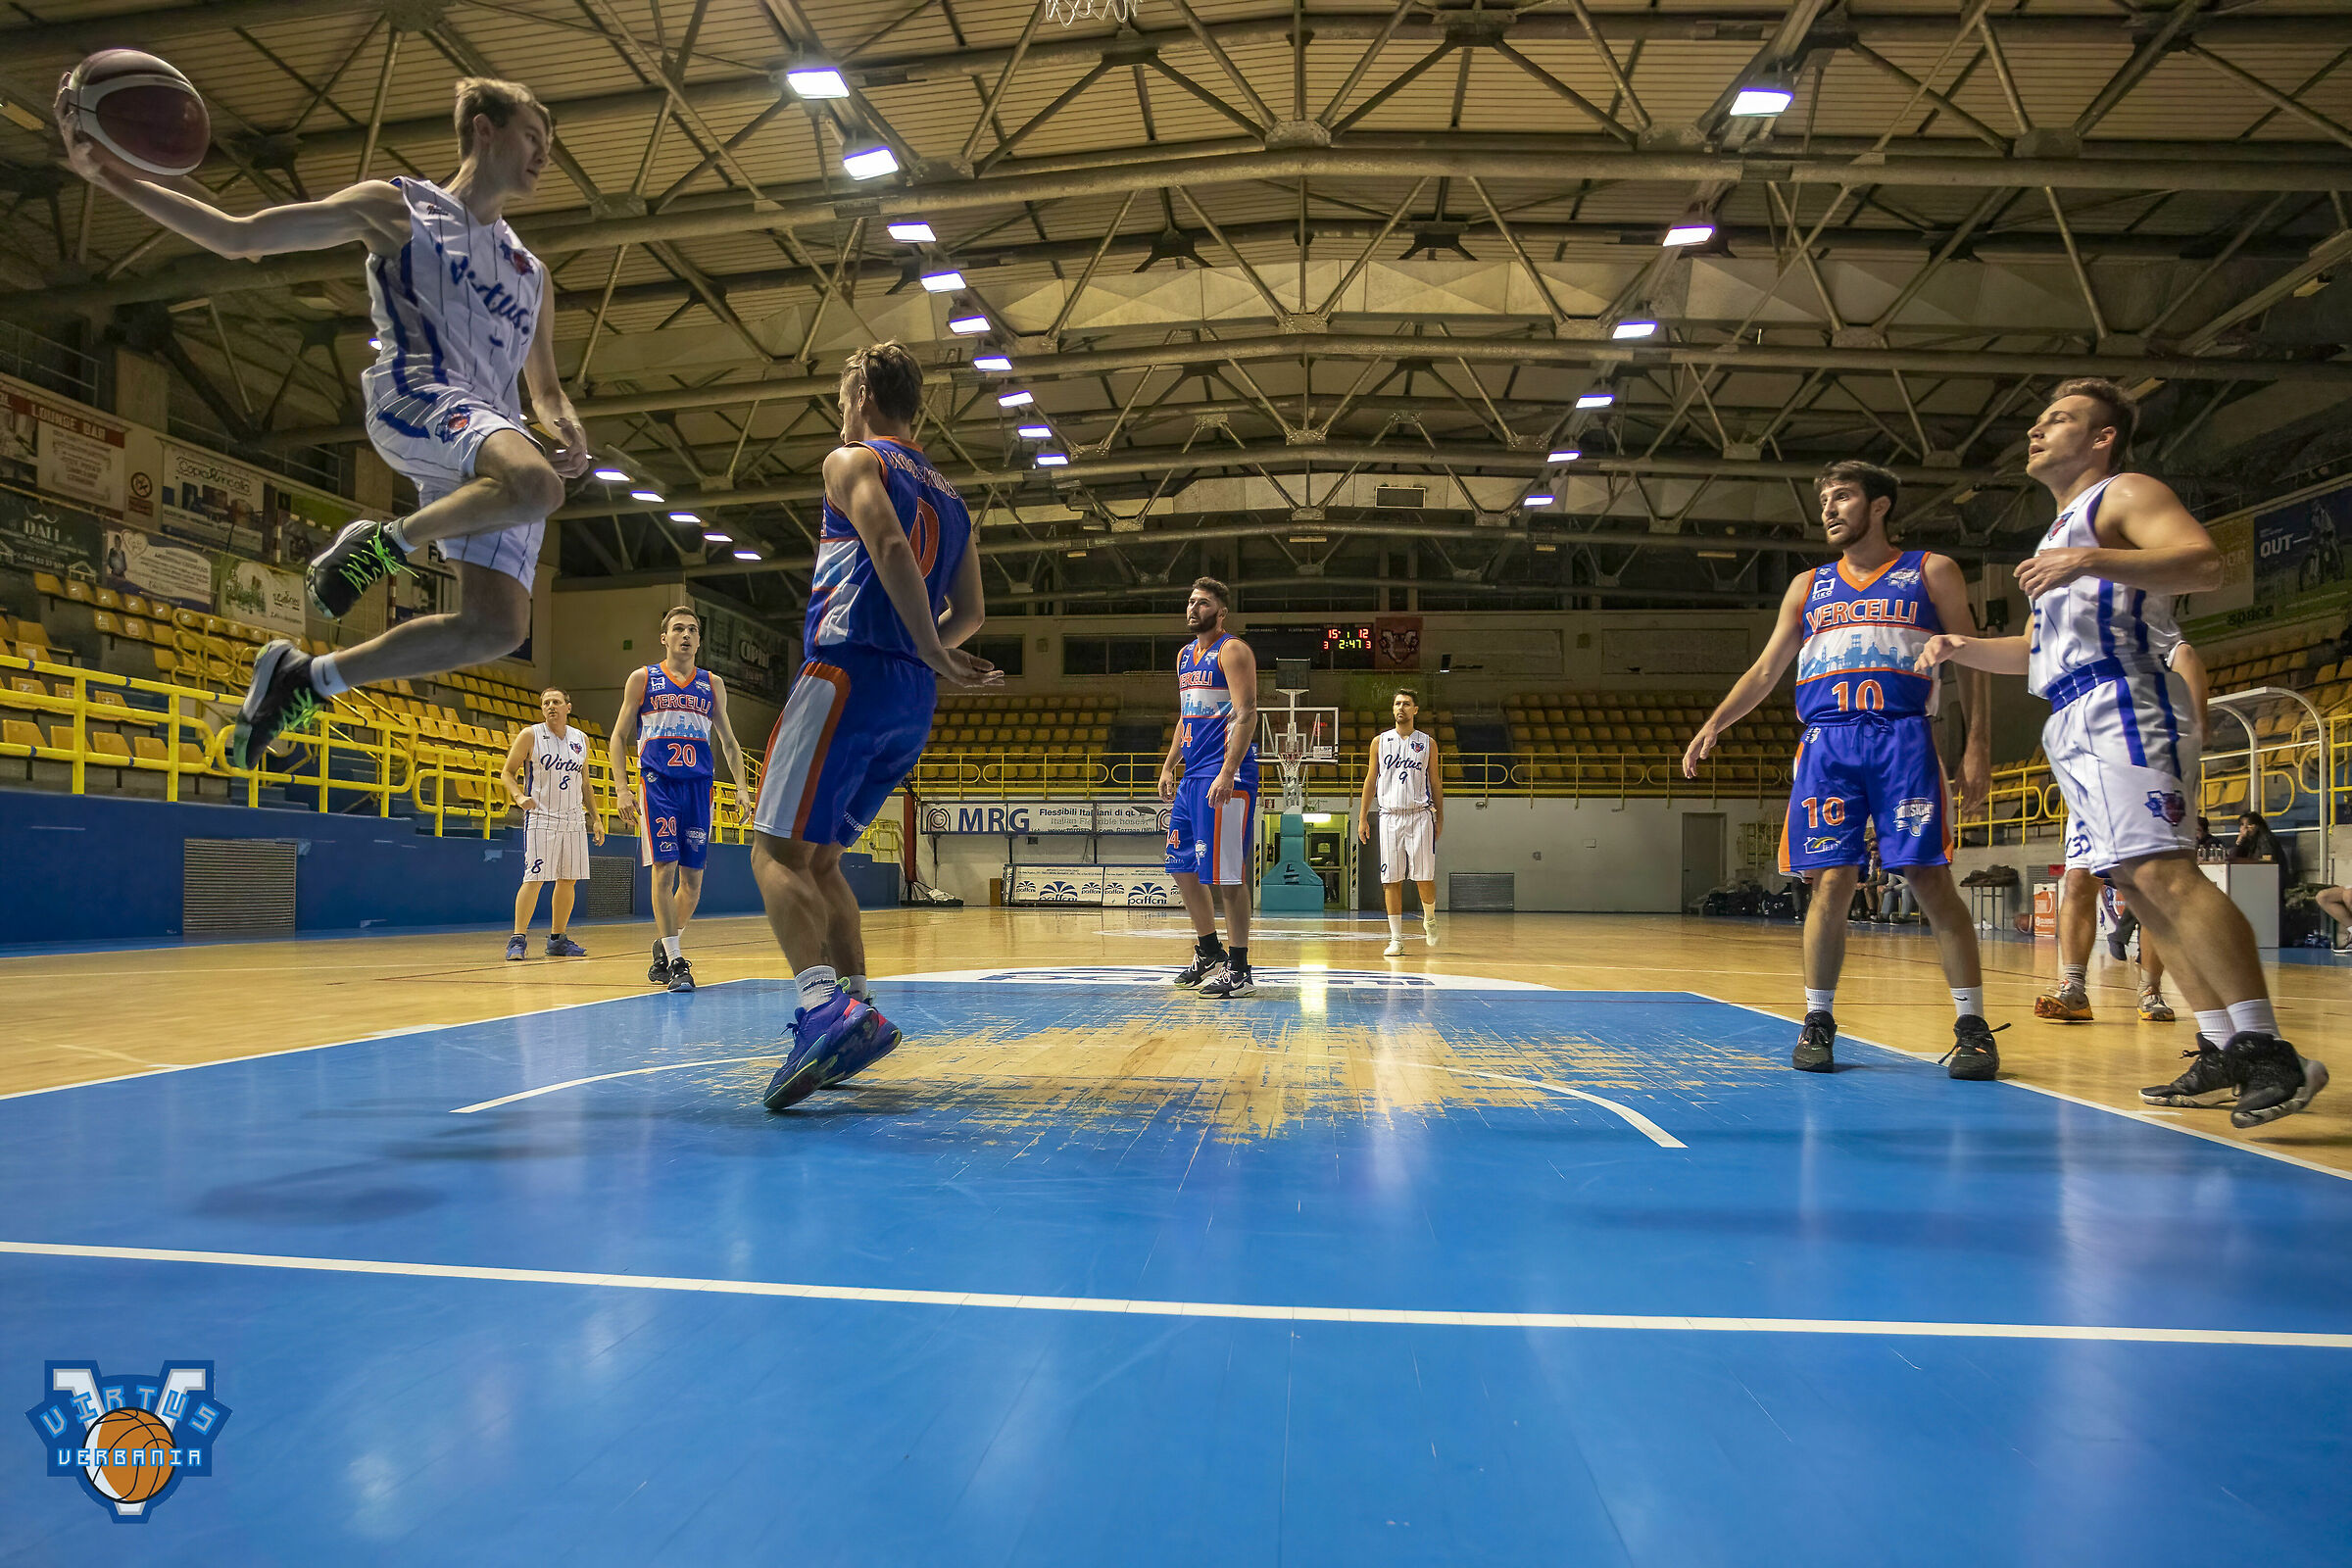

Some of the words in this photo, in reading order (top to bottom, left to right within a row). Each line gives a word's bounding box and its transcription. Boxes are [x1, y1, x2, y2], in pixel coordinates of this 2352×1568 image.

[30, 403, 77, 431] LOUNGE
[82, 419, 107, 442] BAR
[2259, 532, 2294, 560] OUT
[1805, 598, 1919, 633] VERCELLI
[1358, 628, 1369, 639] 12
[1323, 640, 1329, 650] 3
[1338, 639, 1362, 650] 2:47
[1365, 640, 1372, 650] 3
[650, 693, 711, 714] VERCELLI
[1832, 678, 1885, 712] 10
[667, 742, 697, 768] 20
[559, 774, 571, 791] 8
[1398, 771, 1409, 785] 9
[957, 807, 1030, 832] MRG
[1039, 808, 1077, 816] Flessibili
[1801, 796, 1846, 830] 10
[656, 815, 677, 838] 20
[530, 858, 544, 875] 8
[1381, 862, 1388, 876] 9
[1127, 895, 1168, 906] paffoni
[802, 978, 836, 993] adidas
